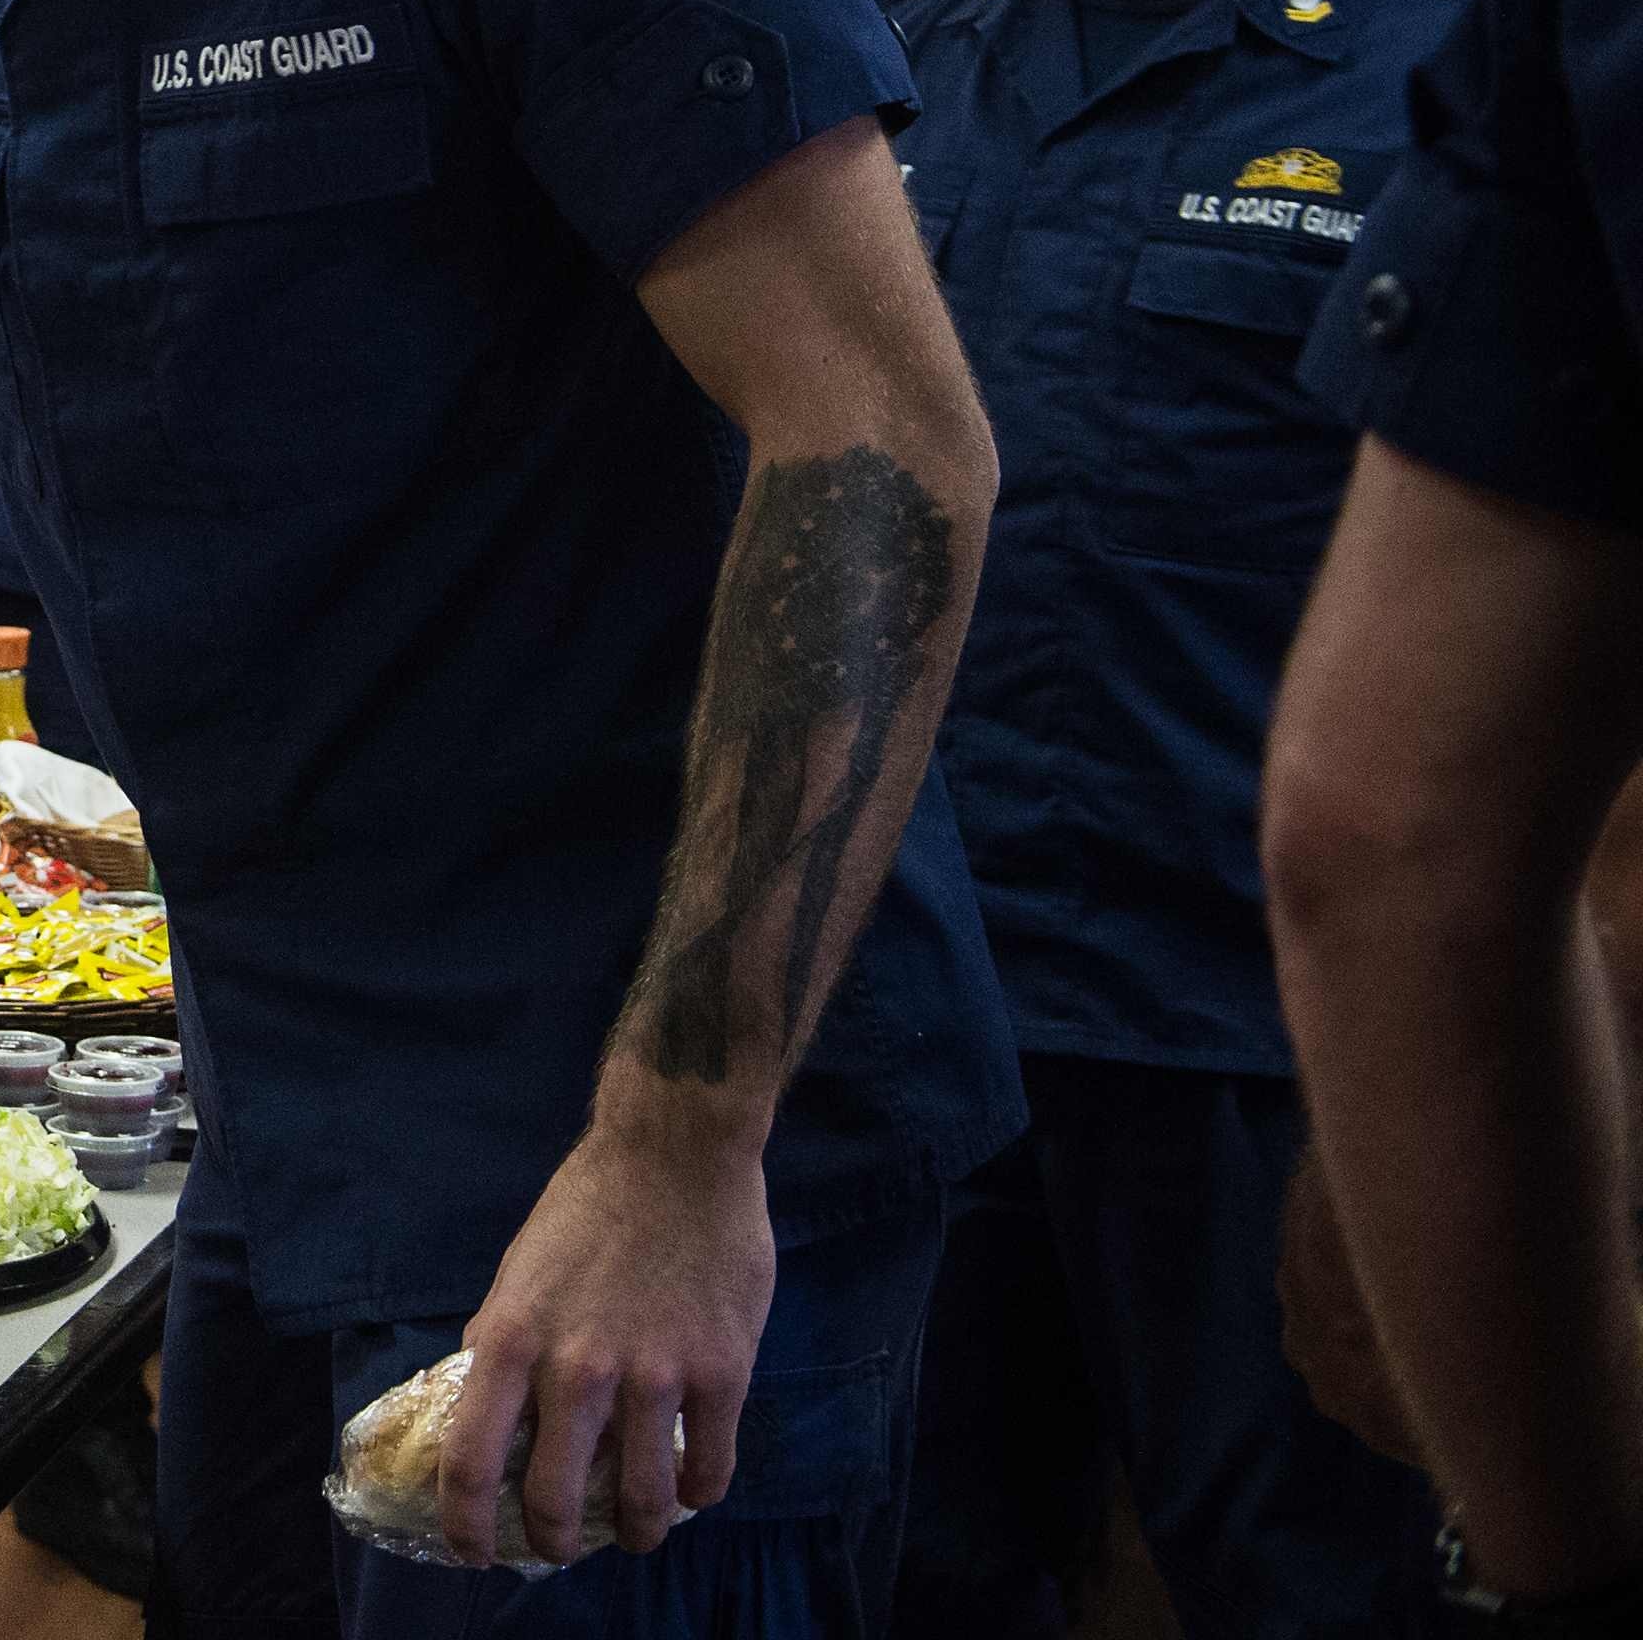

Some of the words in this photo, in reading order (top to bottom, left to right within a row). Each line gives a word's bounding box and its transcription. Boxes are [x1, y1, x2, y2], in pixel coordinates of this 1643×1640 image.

[152, 50, 193, 92] U.S.
[199, 39, 264, 86] COAST
[270, 24, 375, 77] GUARD
[1179, 192, 1221, 223] U.S.
[1225, 197, 1302, 230] COAST
